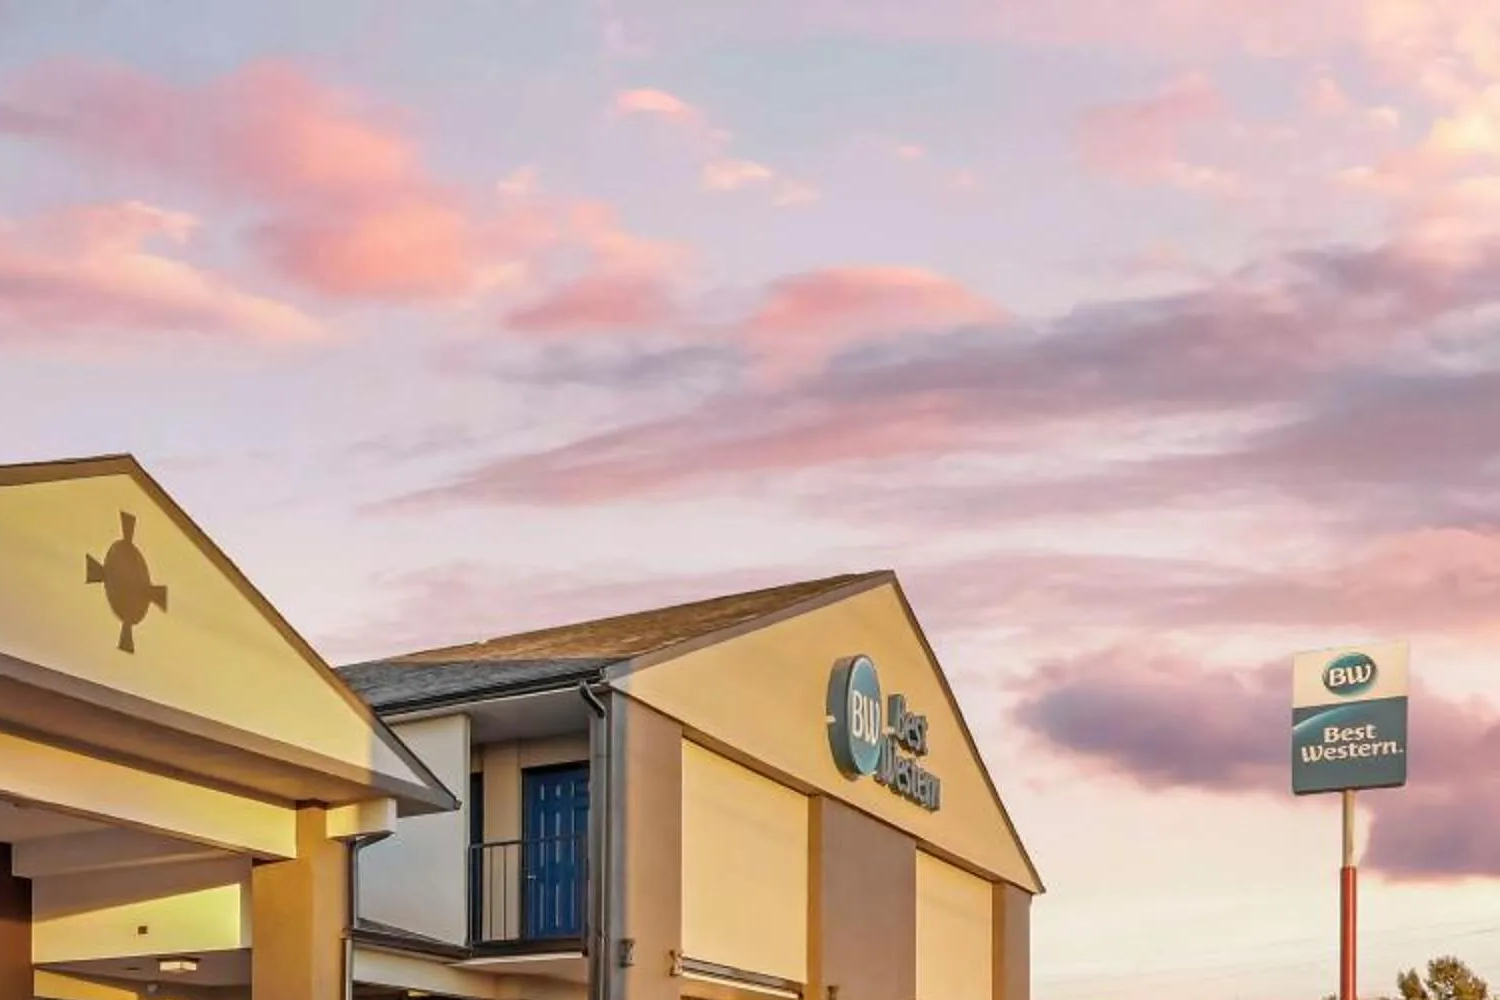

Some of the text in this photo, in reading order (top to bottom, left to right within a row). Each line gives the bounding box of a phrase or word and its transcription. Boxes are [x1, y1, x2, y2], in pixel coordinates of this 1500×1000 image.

[1330, 665, 1371, 686] BW
[853, 690, 880, 745] BW
[1324, 725, 1377, 743] Best
